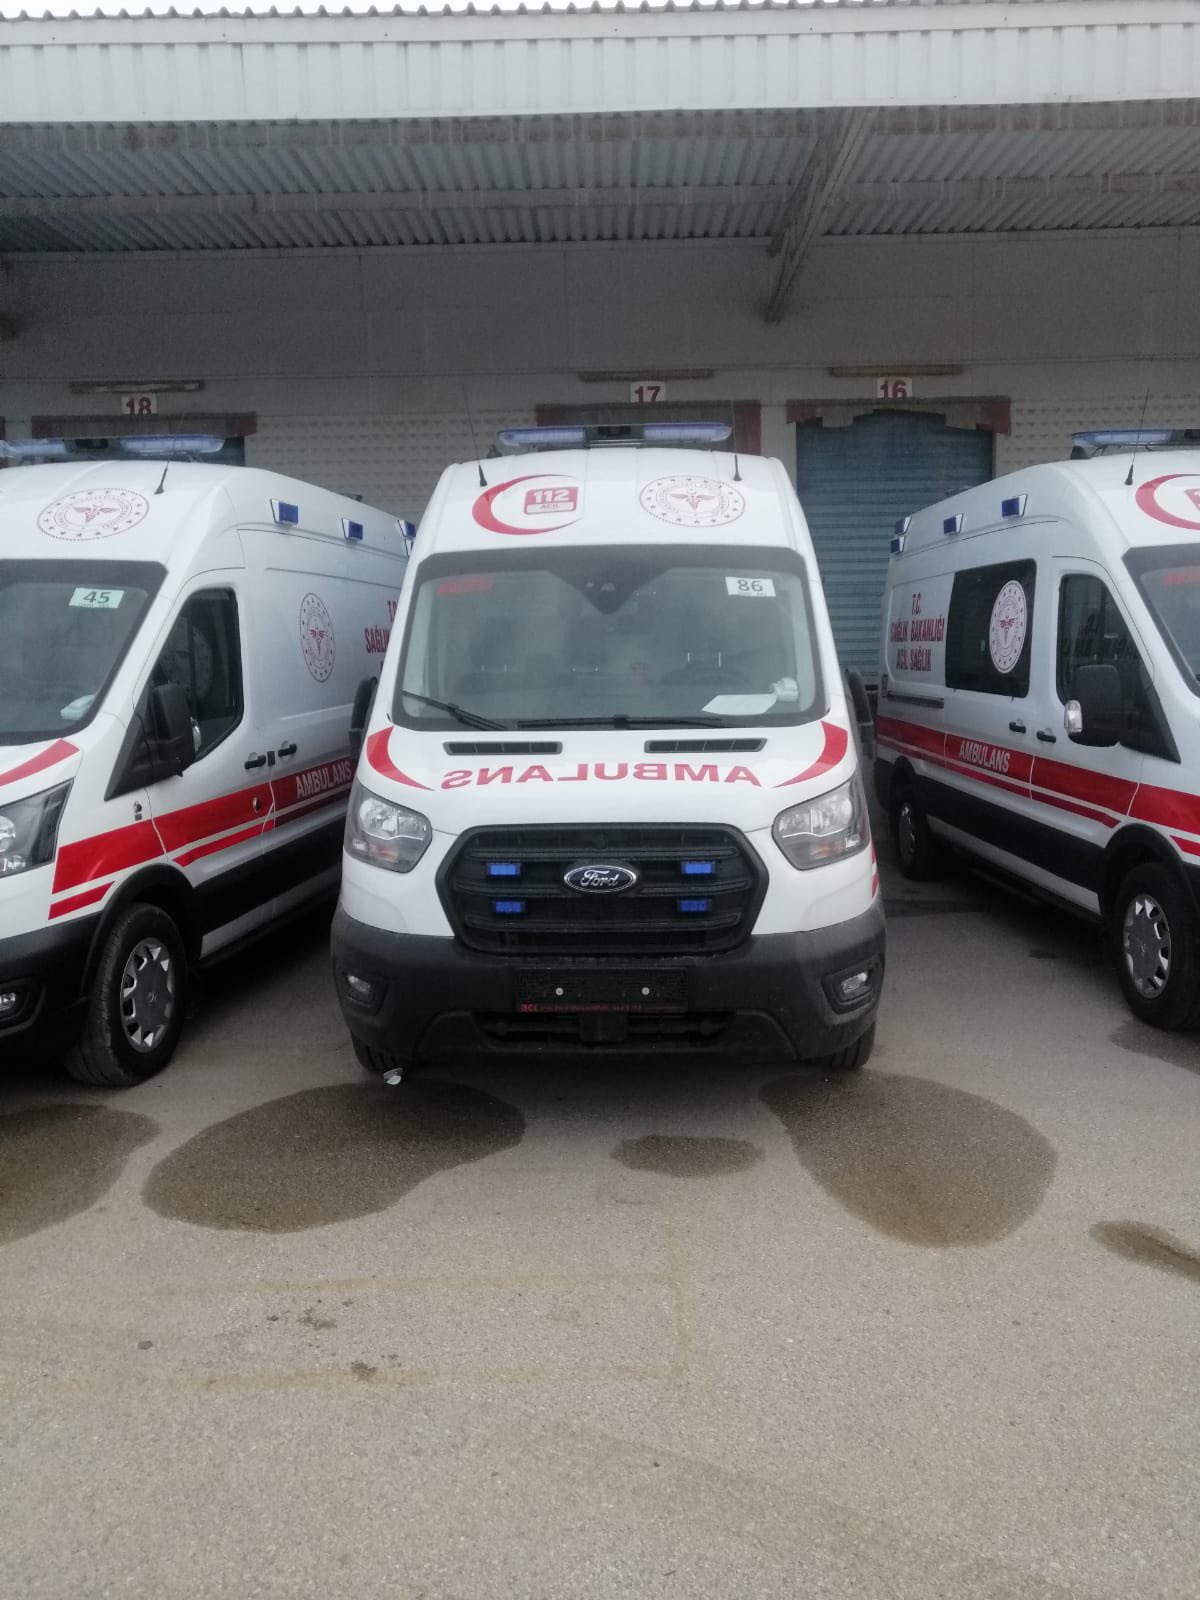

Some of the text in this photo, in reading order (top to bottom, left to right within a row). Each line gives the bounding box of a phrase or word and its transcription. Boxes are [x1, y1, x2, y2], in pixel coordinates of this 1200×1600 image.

[634, 385, 661, 402] 17
[880, 379, 907, 400] 16
[126, 397, 152, 415] 18
[533, 489, 569, 503] 112
[737, 580, 763, 592] 86
[83, 591, 111, 604] 45
[959, 740, 1010, 773] AMBULANS
[296, 761, 352, 799] AMBULANS
[580, 869, 619, 887] Ford
